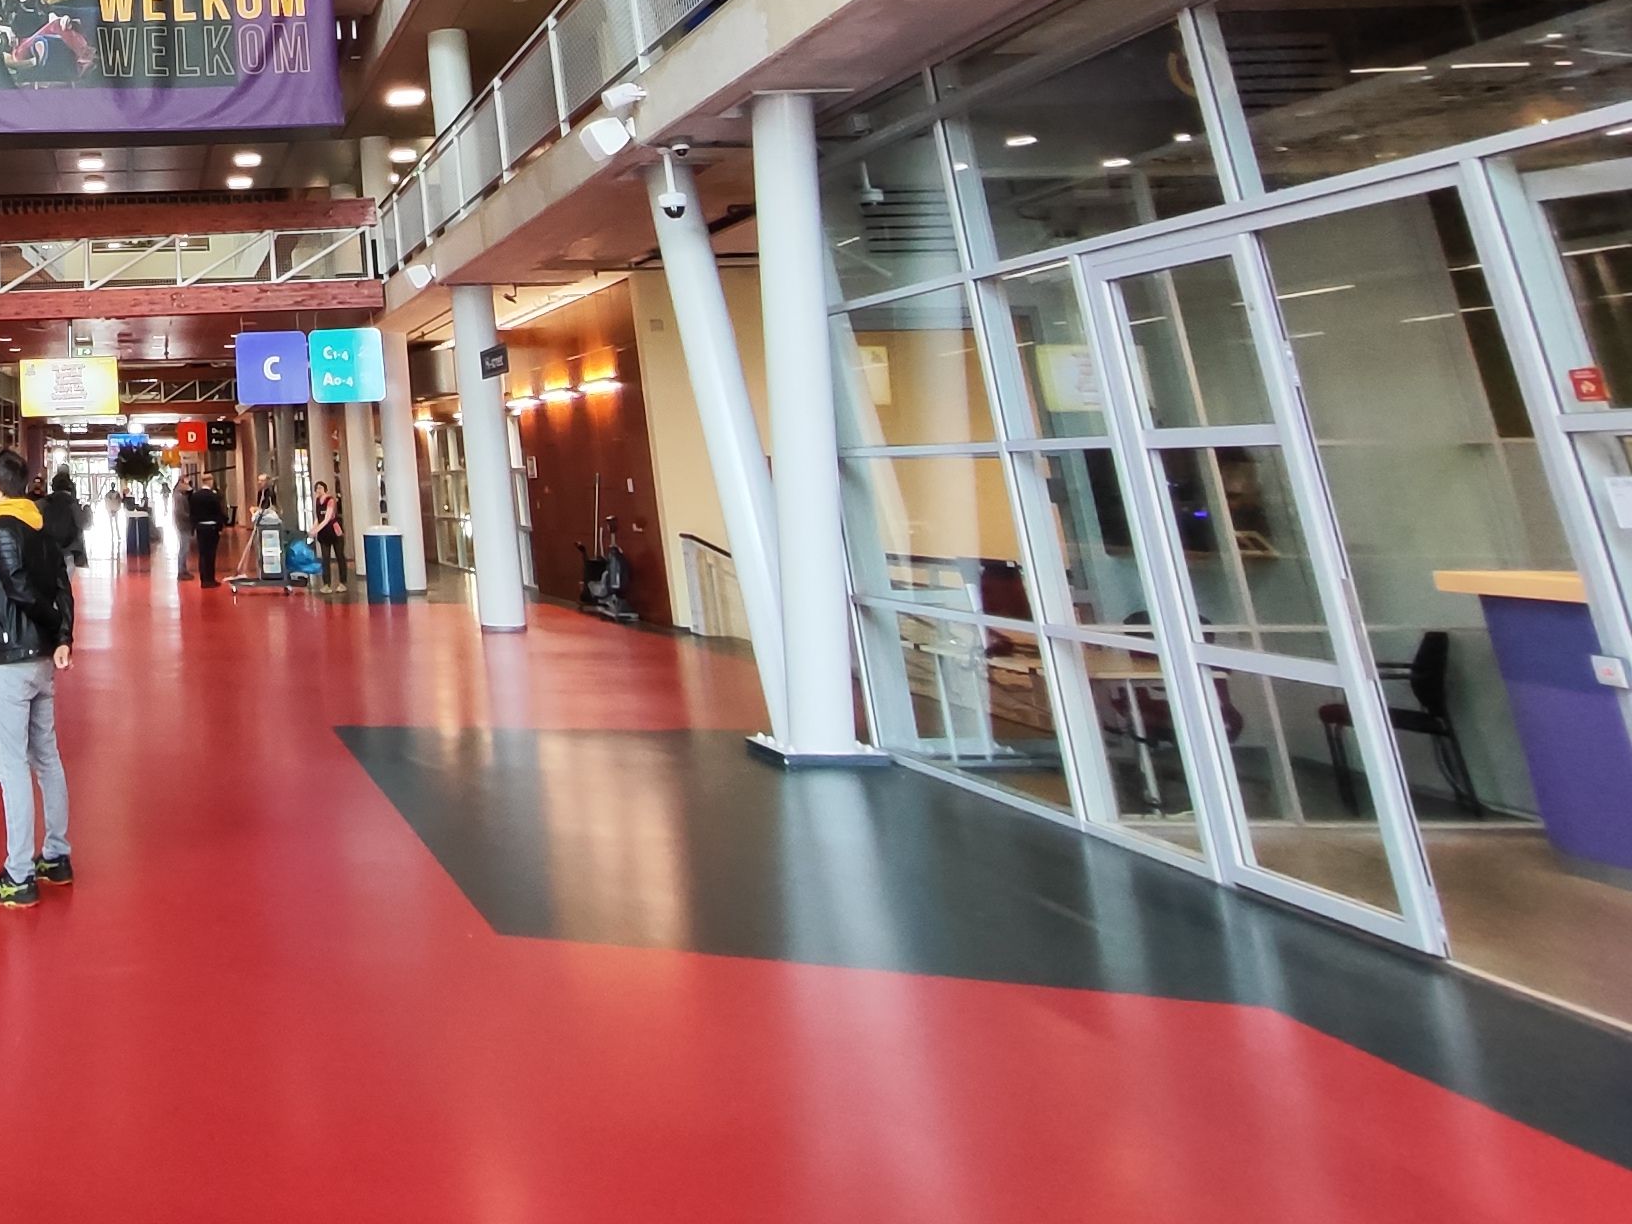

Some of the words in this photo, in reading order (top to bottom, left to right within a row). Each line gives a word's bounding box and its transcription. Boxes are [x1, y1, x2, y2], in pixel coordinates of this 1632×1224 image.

[96, 22, 311, 78] WELKOM
[263, 355, 282, 381] C
[187, 431, 197, 443] D
